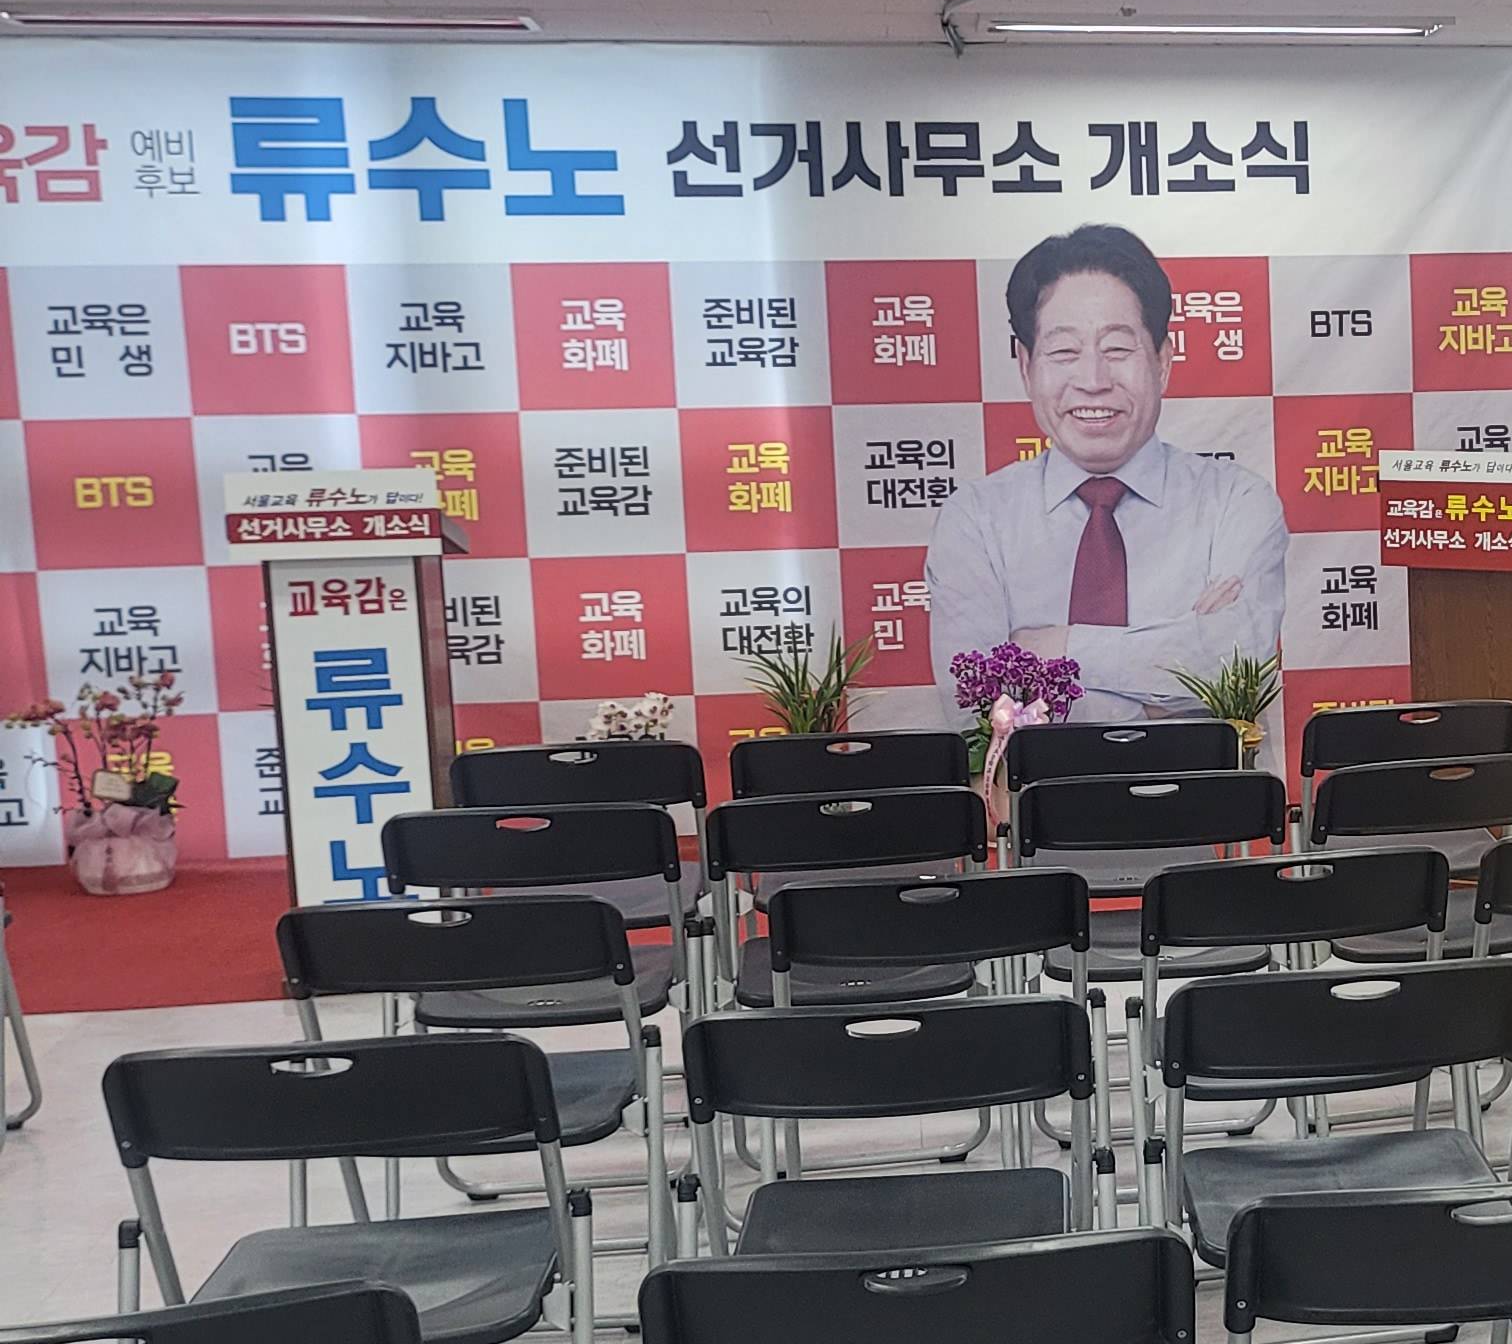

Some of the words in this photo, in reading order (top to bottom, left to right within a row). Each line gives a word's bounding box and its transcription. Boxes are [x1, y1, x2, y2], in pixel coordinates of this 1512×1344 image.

[131, 129, 195, 163] 예비
[229, 97, 625, 221] 류수노
[666, 120, 1062, 198] 선거사무소
[1088, 120, 1311, 196] 개소식
[0, 124, 108, 203] 감
[135, 165, 200, 199] 후보
[399, 301, 465, 333] 교육
[559, 298, 627, 333] 교육
[702, 297, 798, 331] 준비된
[872, 294, 935, 327] 교육
[1451, 286, 1509, 317] 교육
[47, 304, 150, 336] 교육은
[1310, 310, 1373, 338] BTS
[228, 322, 308, 355] BTS
[562, 337, 629, 372] 화폐
[705, 335, 800, 369] 교육감
[874, 332, 938, 366] 화폐
[385, 340, 485, 374] 지바고
[1316, 427, 1374, 458] 교육
[1455, 424, 1511, 452] 교육
[554, 446, 650, 478] 준비된
[726, 442, 791, 474] 교육
[864, 439, 955, 470] 교육의
[1391, 459, 1434, 471] 서울교육
[73, 477, 155, 510] BTS
[438, 487, 480, 521] 폐
[557, 485, 652, 517] 교육감
[728, 480, 792, 513] 화폐
[236, 516, 353, 541] 선거사무소
[362, 513, 431, 538] 개소식
[1383, 528, 1467, 551] 선거사무소
[1321, 565, 1378, 595] 교육
[288, 577, 408, 617] 교육감은
[579, 590, 644, 622] 교육
[719, 585, 812, 617] 교육의
[93, 605, 161, 637] 교육
[1321, 600, 1379, 631] 화폐
[581, 629, 647, 661] 화폐
[722, 622, 815, 656] 대전환
[79, 645, 183, 677] 지바고
